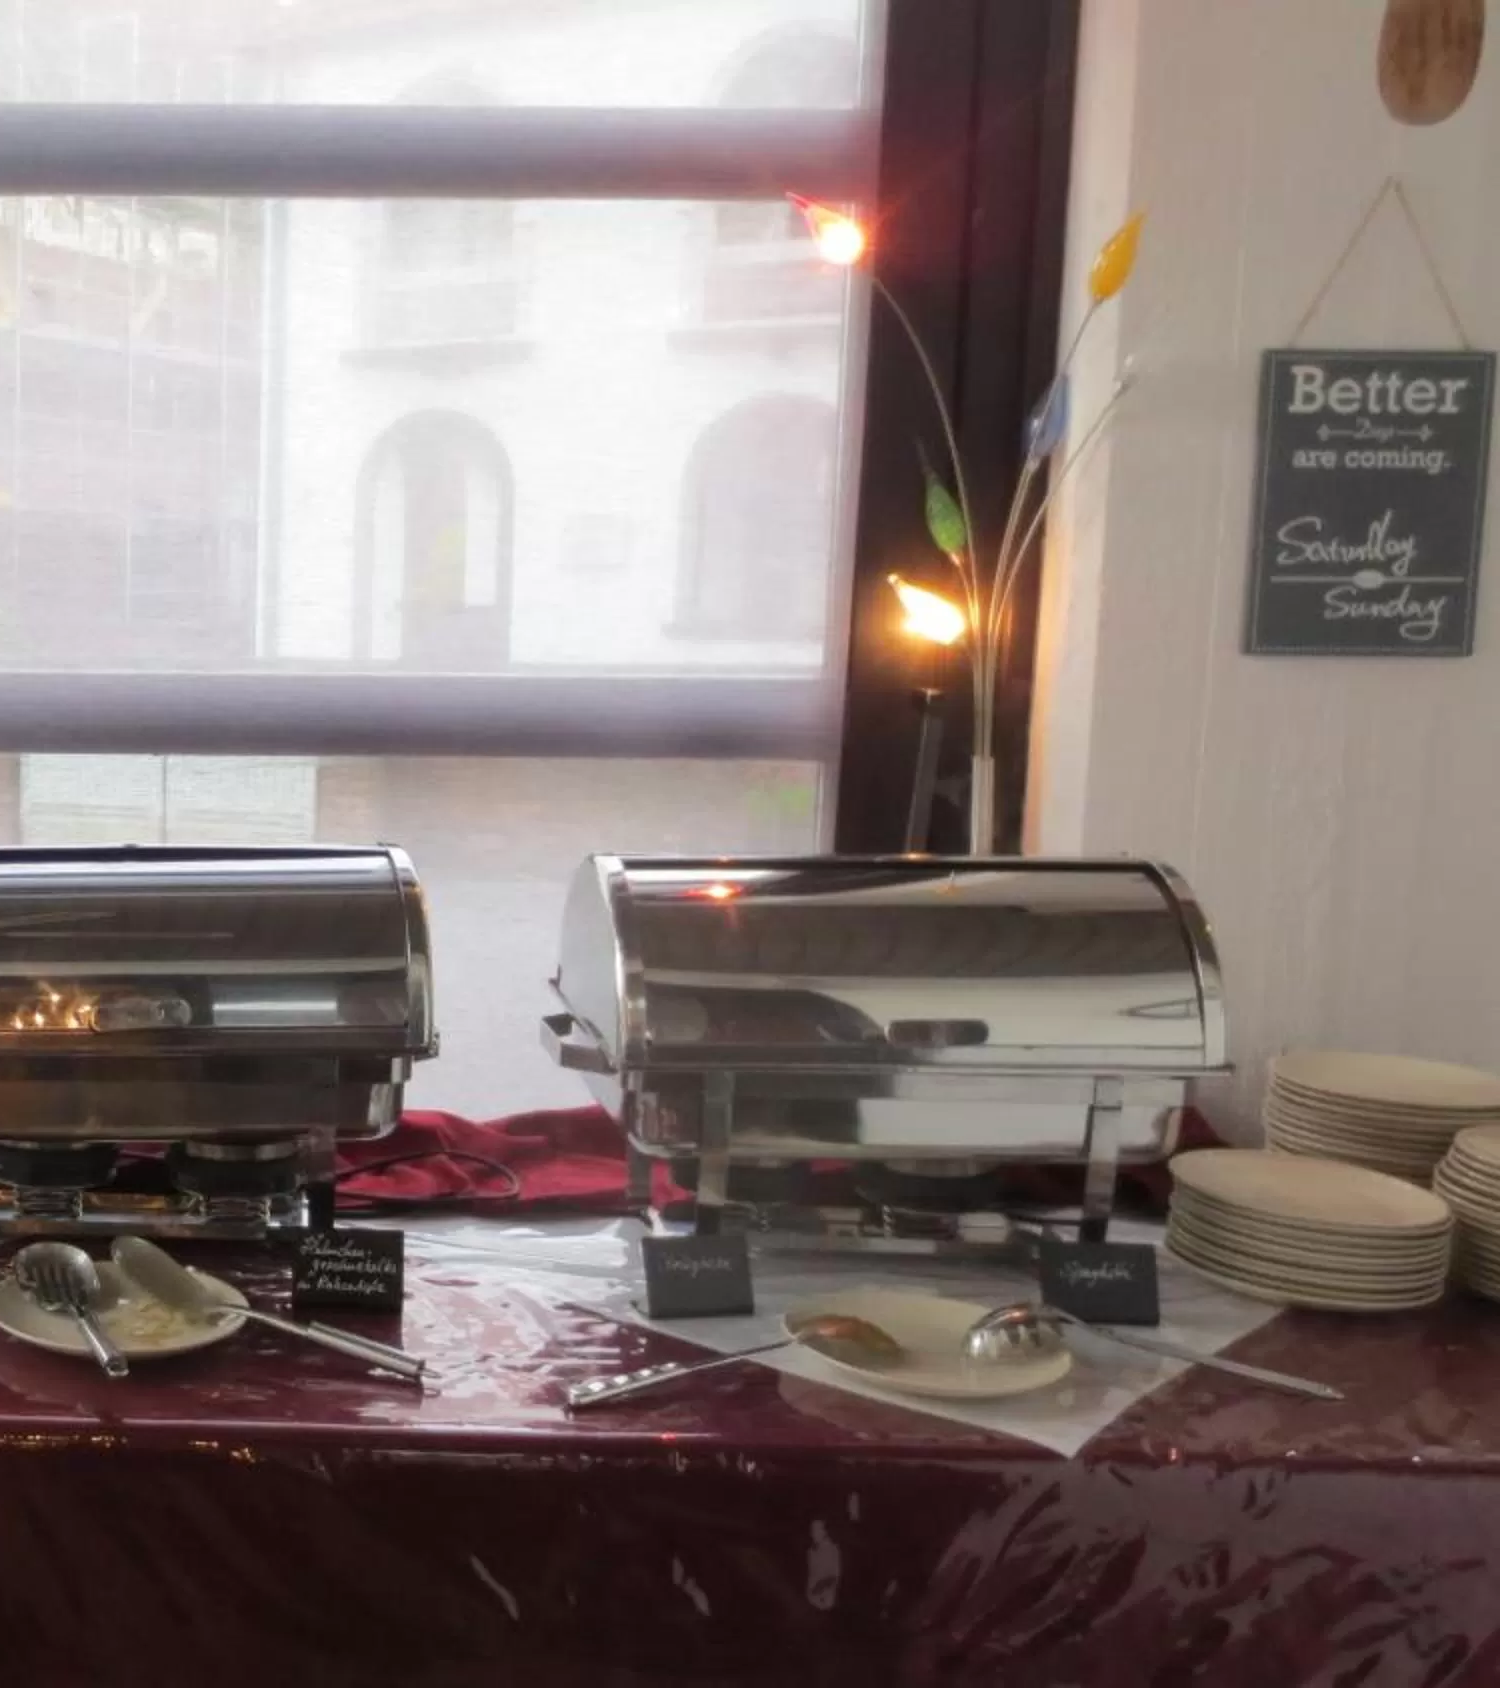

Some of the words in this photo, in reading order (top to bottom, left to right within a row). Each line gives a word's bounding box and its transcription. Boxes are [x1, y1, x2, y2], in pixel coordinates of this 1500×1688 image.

[1288, 364, 1469, 415] Better
[1291, 450, 1337, 470] are
[1276, 508, 1417, 577] Saturday
[1322, 583, 1449, 641] Sunday
